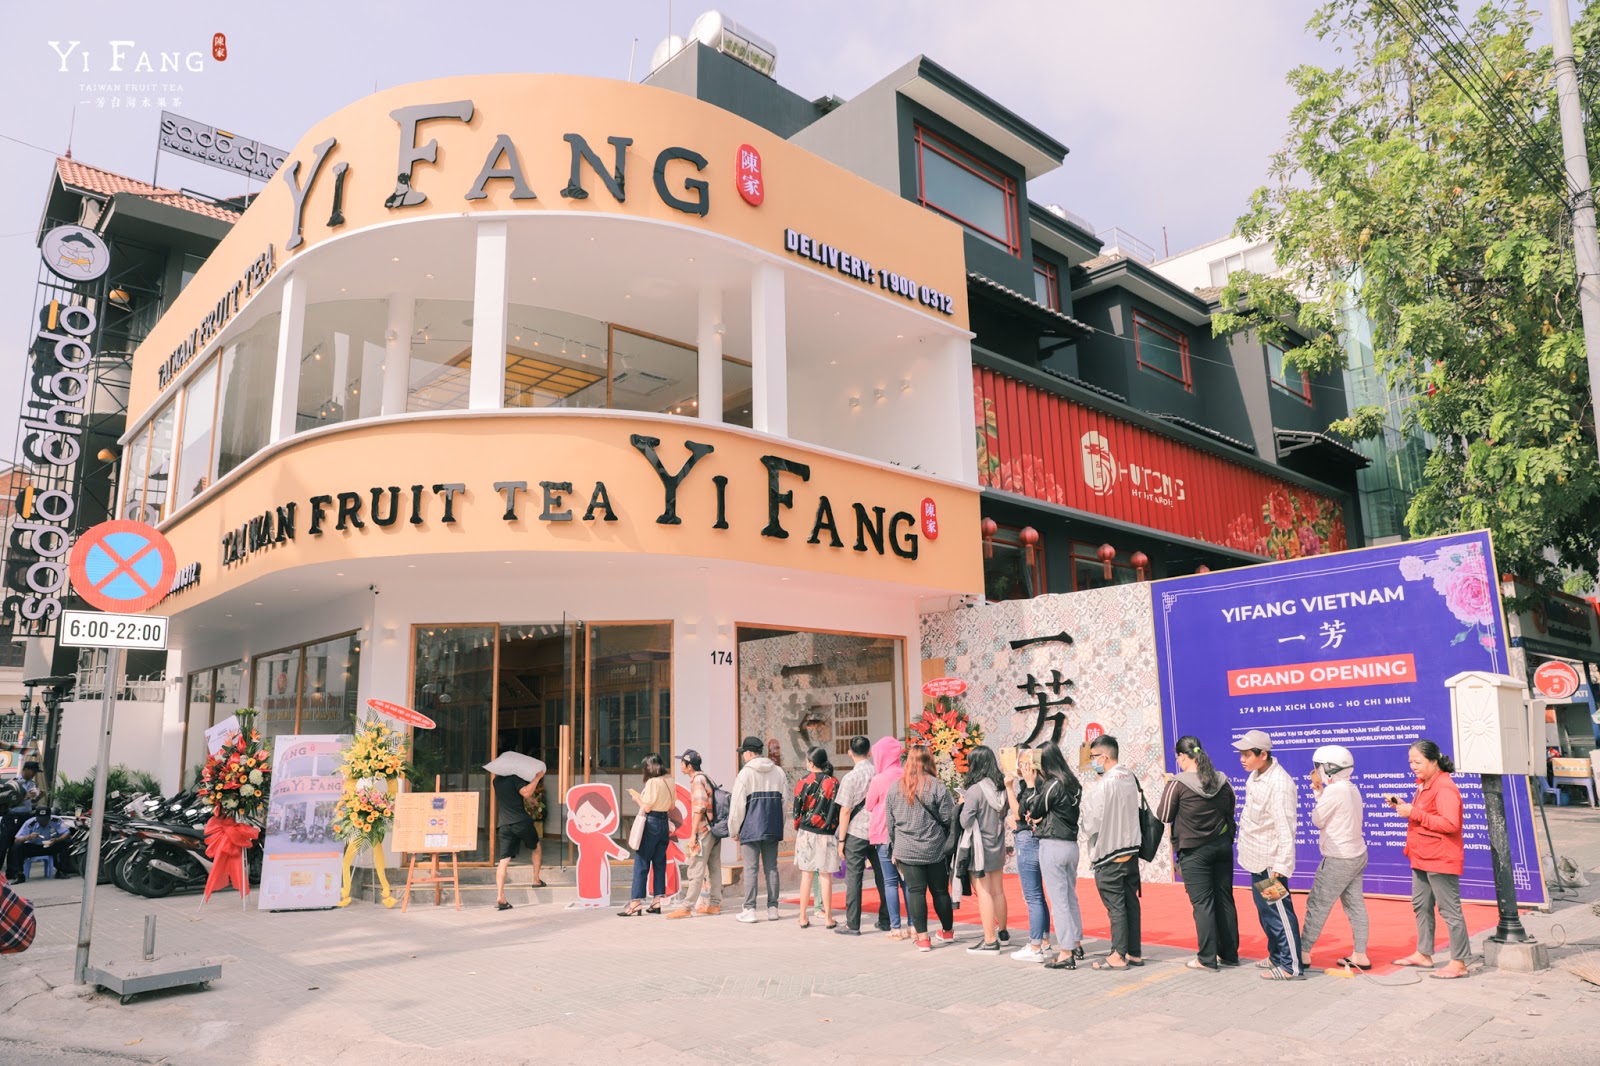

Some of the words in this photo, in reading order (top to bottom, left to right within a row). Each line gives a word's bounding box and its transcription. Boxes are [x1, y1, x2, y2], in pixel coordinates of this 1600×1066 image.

[384, 99, 709, 218] FANG
[740, 149, 761, 197] 陳家
[784, 227, 877, 284] DELIVERY:
[878, 269, 917, 300] 1900
[918, 284, 955, 316] 0312
[158, 328, 198, 391] TAIWAN
[199, 280, 242, 347] FRUIT
[244, 243, 277, 298] TEA
[221, 501, 297, 567] TAIWAN
[308, 482, 467, 536] FRUIT
[493, 481, 620, 523] TEA
[759, 454, 919, 561] FANG
[1221, 599, 1297, 623] YIFANG
[1300, 584, 1406, 614] VIETNAM
[69, 619, 162, 644] 6:00-22:00
[1277, 619, 1347, 650] 一芳
[710, 650, 733, 666] 174
[1235, 669, 1305, 689] GRAND
[1309, 659, 1408, 683] OPENING
[1239, 707, 1255, 715] 174
[1257, 705, 1282, 714] PHAN
[1284, 703, 1307, 712] XICH
[1309, 701, 1335, 710] LONG
[1346, 700, 1360, 708] HO
[1363, 698, 1381, 706] CHI
[1384, 696, 1411, 705] MINH
[1355, 734, 1396, 742] WORLDWIDE
